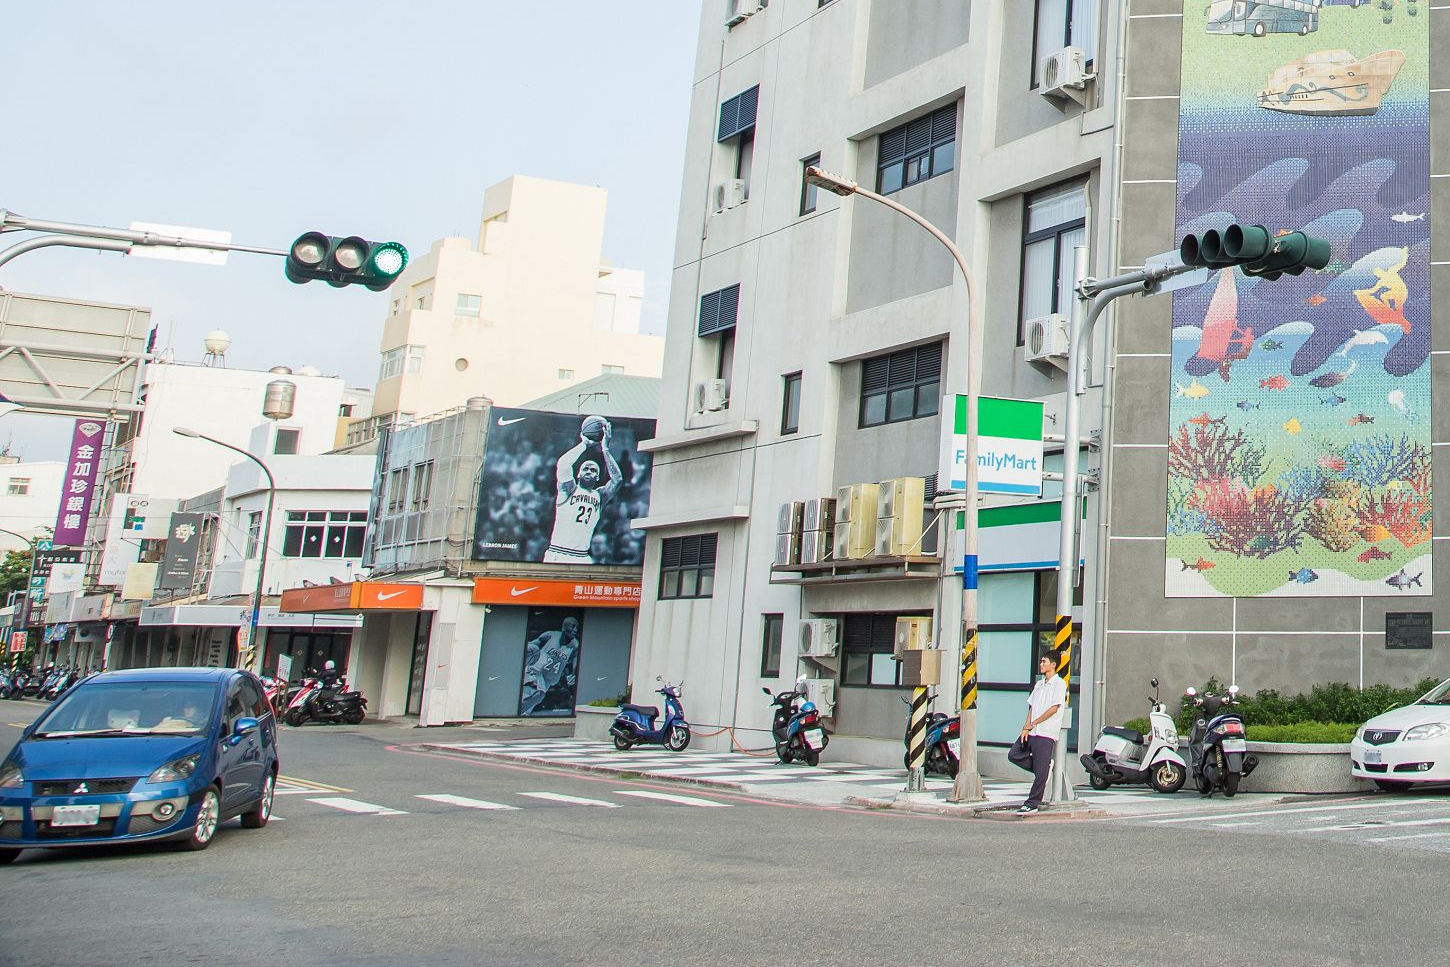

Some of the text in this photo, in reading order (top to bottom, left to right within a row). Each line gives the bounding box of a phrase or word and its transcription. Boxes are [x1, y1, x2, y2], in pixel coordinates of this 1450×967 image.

[64, 444, 95, 529] 金加珍銀樓
[576, 505, 593, 525] 23
[574, 585, 641, 596] 青山運動專門店
[543, 657, 561, 674] 24
